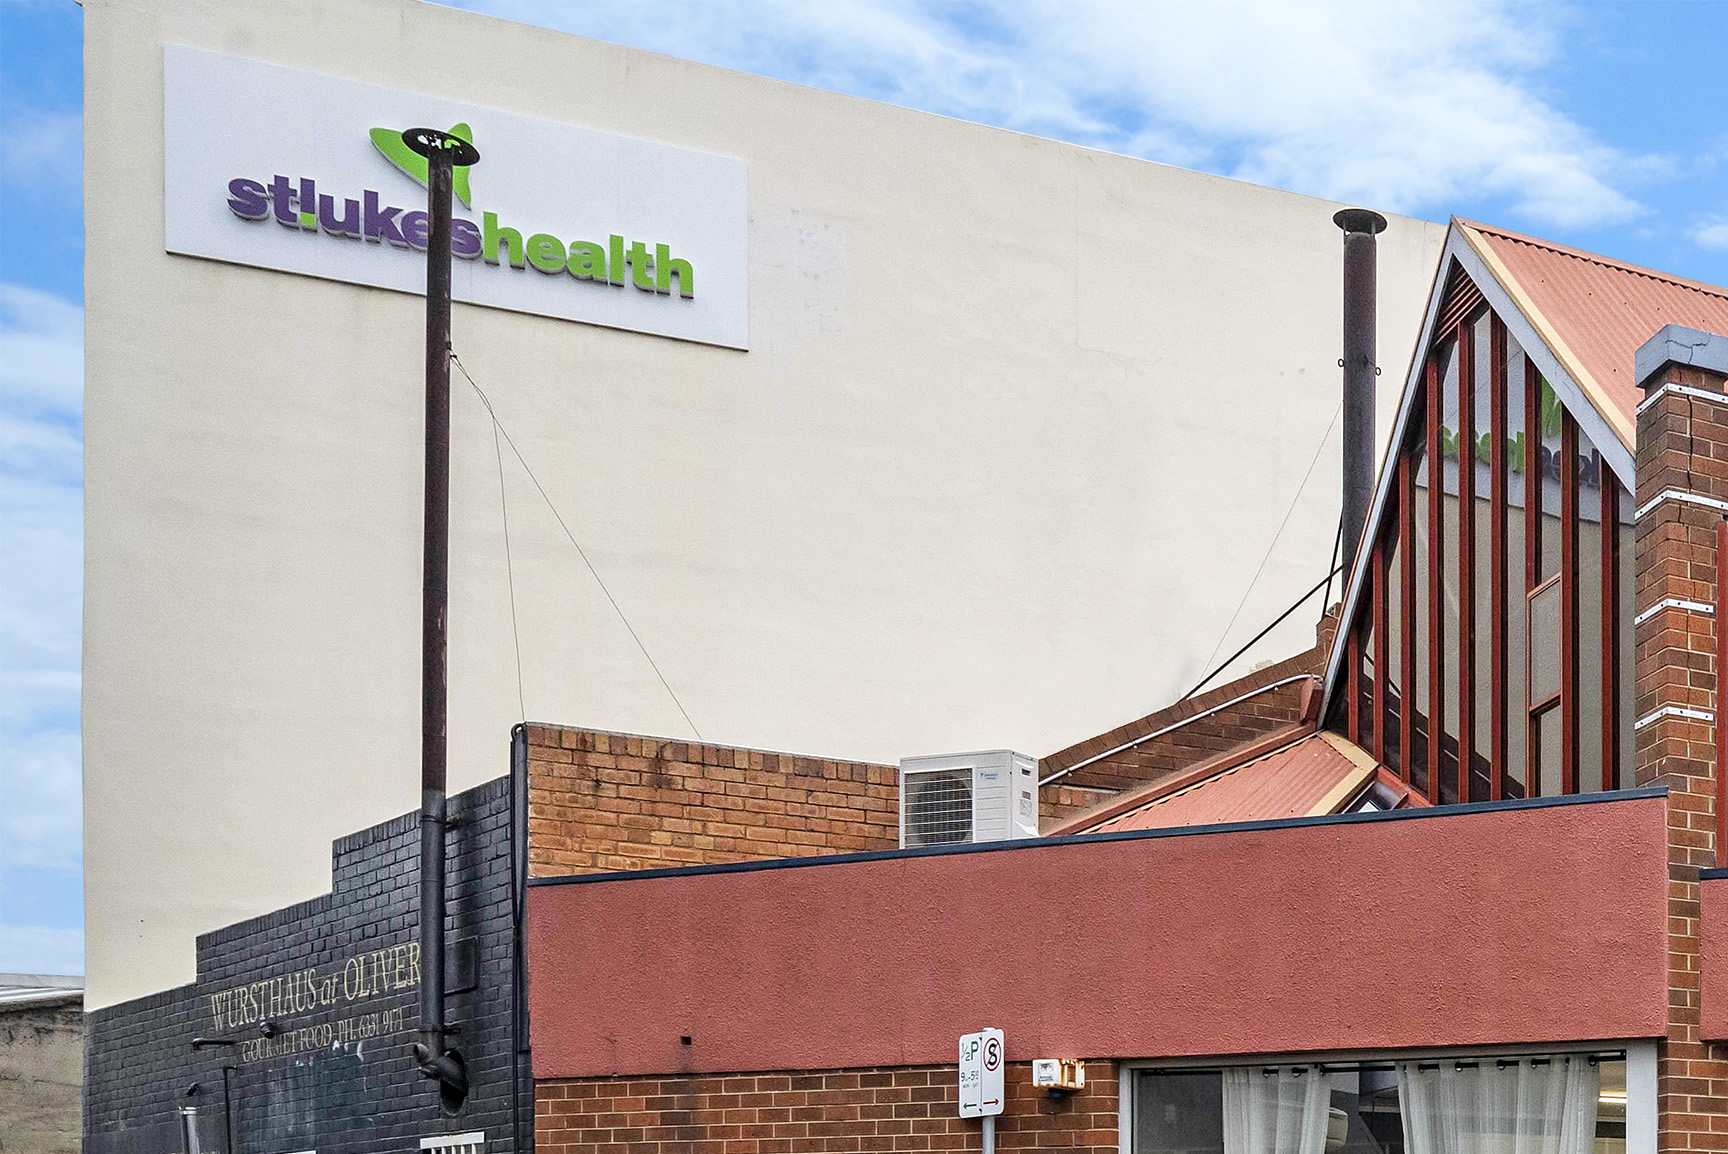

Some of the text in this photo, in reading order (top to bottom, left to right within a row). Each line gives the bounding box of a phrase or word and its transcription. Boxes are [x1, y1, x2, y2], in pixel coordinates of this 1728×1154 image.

[210, 968, 317, 1032] WURSTHAUS
[320, 973, 339, 1006] at
[242, 1031, 298, 1062] GOURMET
[299, 1023, 333, 1051] FOOD
